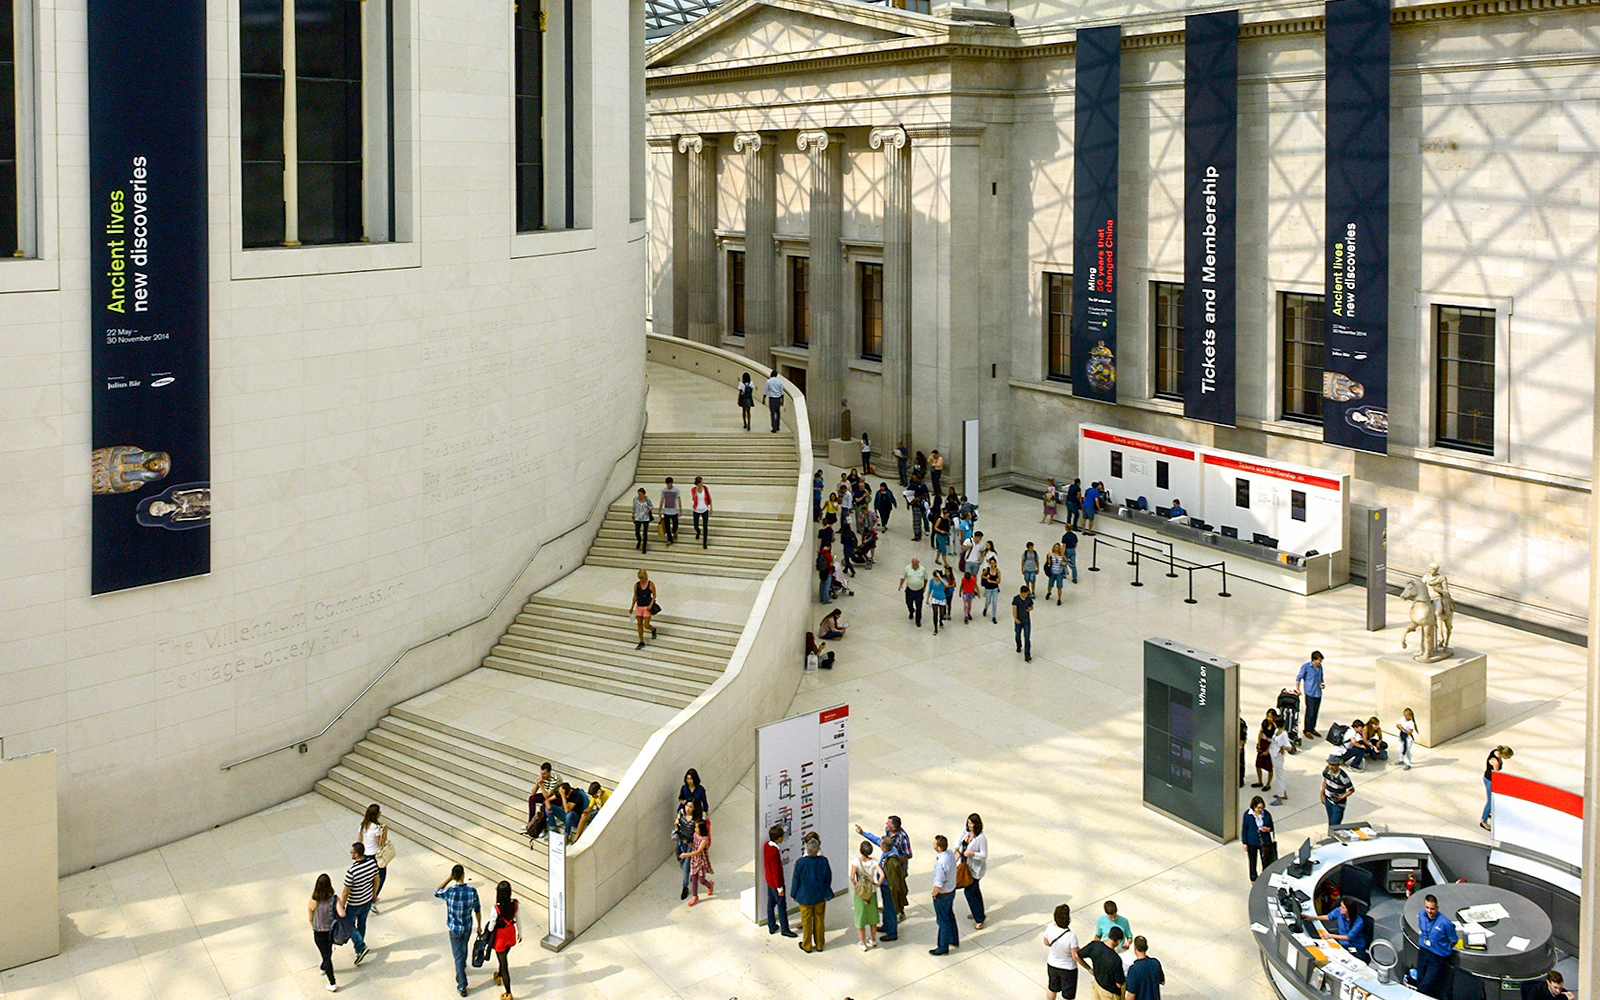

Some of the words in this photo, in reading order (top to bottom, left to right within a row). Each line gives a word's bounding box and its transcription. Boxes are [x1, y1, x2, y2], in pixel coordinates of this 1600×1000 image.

[106, 190, 125, 234] lives
[129, 155, 148, 266] discoveries
[1202, 165, 1220, 283] Membership
[1097, 228, 1105, 248] that
[1105, 219, 1114, 248] China
[1097, 250, 1105, 277] years
[1332, 242, 1344, 269] lives
[1344, 222, 1357, 290] discoveries
[106, 240, 125, 314] Ancient
[1088, 267, 1097, 291] Ming
[1096, 278, 1104, 292] 50
[1105, 250, 1114, 293] changed
[134, 272, 149, 312] new
[1332, 271, 1343, 317] Ancient
[1346, 292, 1355, 318] new
[1202, 289, 1216, 324] and
[106, 329, 116, 337] 22
[117, 328, 132, 337] May
[106, 337, 117, 345] 30
[118, 334, 152, 344] November
[152, 333, 170, 341] 2014
[1201, 328, 1216, 394] Tickets
[107, 381, 128, 390] Julius
[1112, 436, 1127, 444] Tickets
[1238, 462, 1255, 472] Tickets
[1200, 665, 1207, 678] on
[1199, 678, 1207, 706] What's
